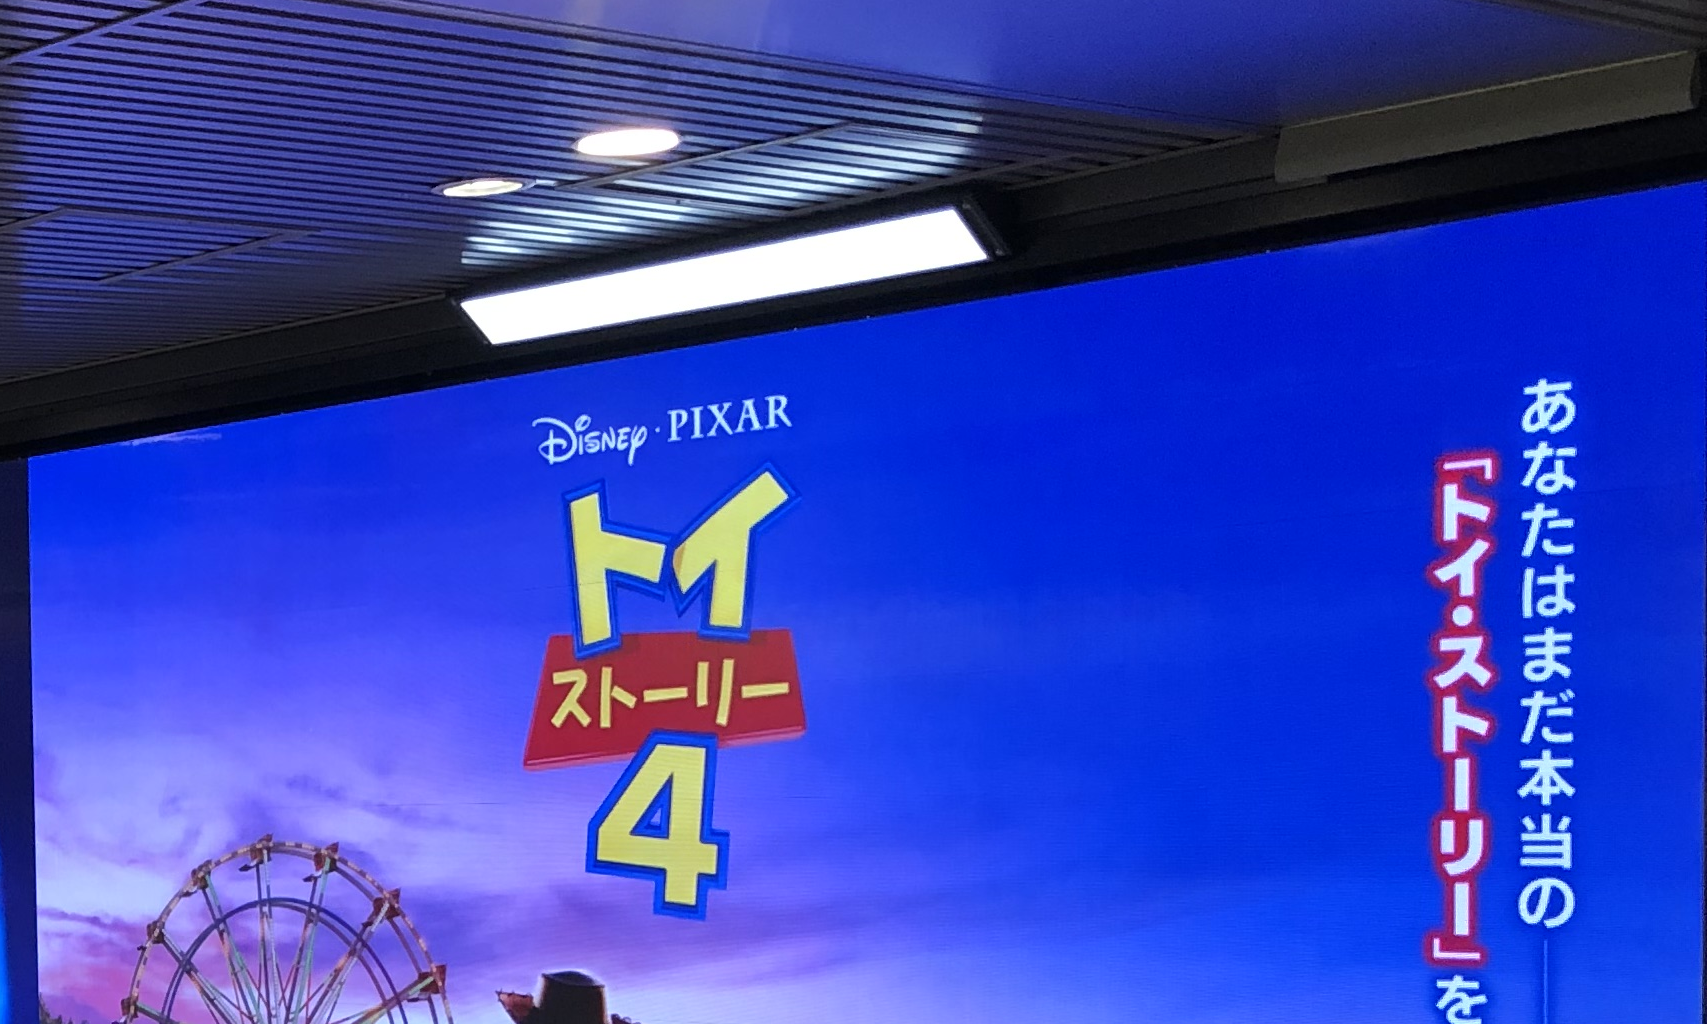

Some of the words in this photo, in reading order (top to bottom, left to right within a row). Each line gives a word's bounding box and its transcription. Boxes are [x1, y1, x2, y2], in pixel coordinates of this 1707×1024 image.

[667, 394, 792, 443] PIXAR
[550, 658, 790, 728] ストーリー
[1517, 378, 1577, 929] あなたはまだ本当の
[587, 730, 728, 919] 4
